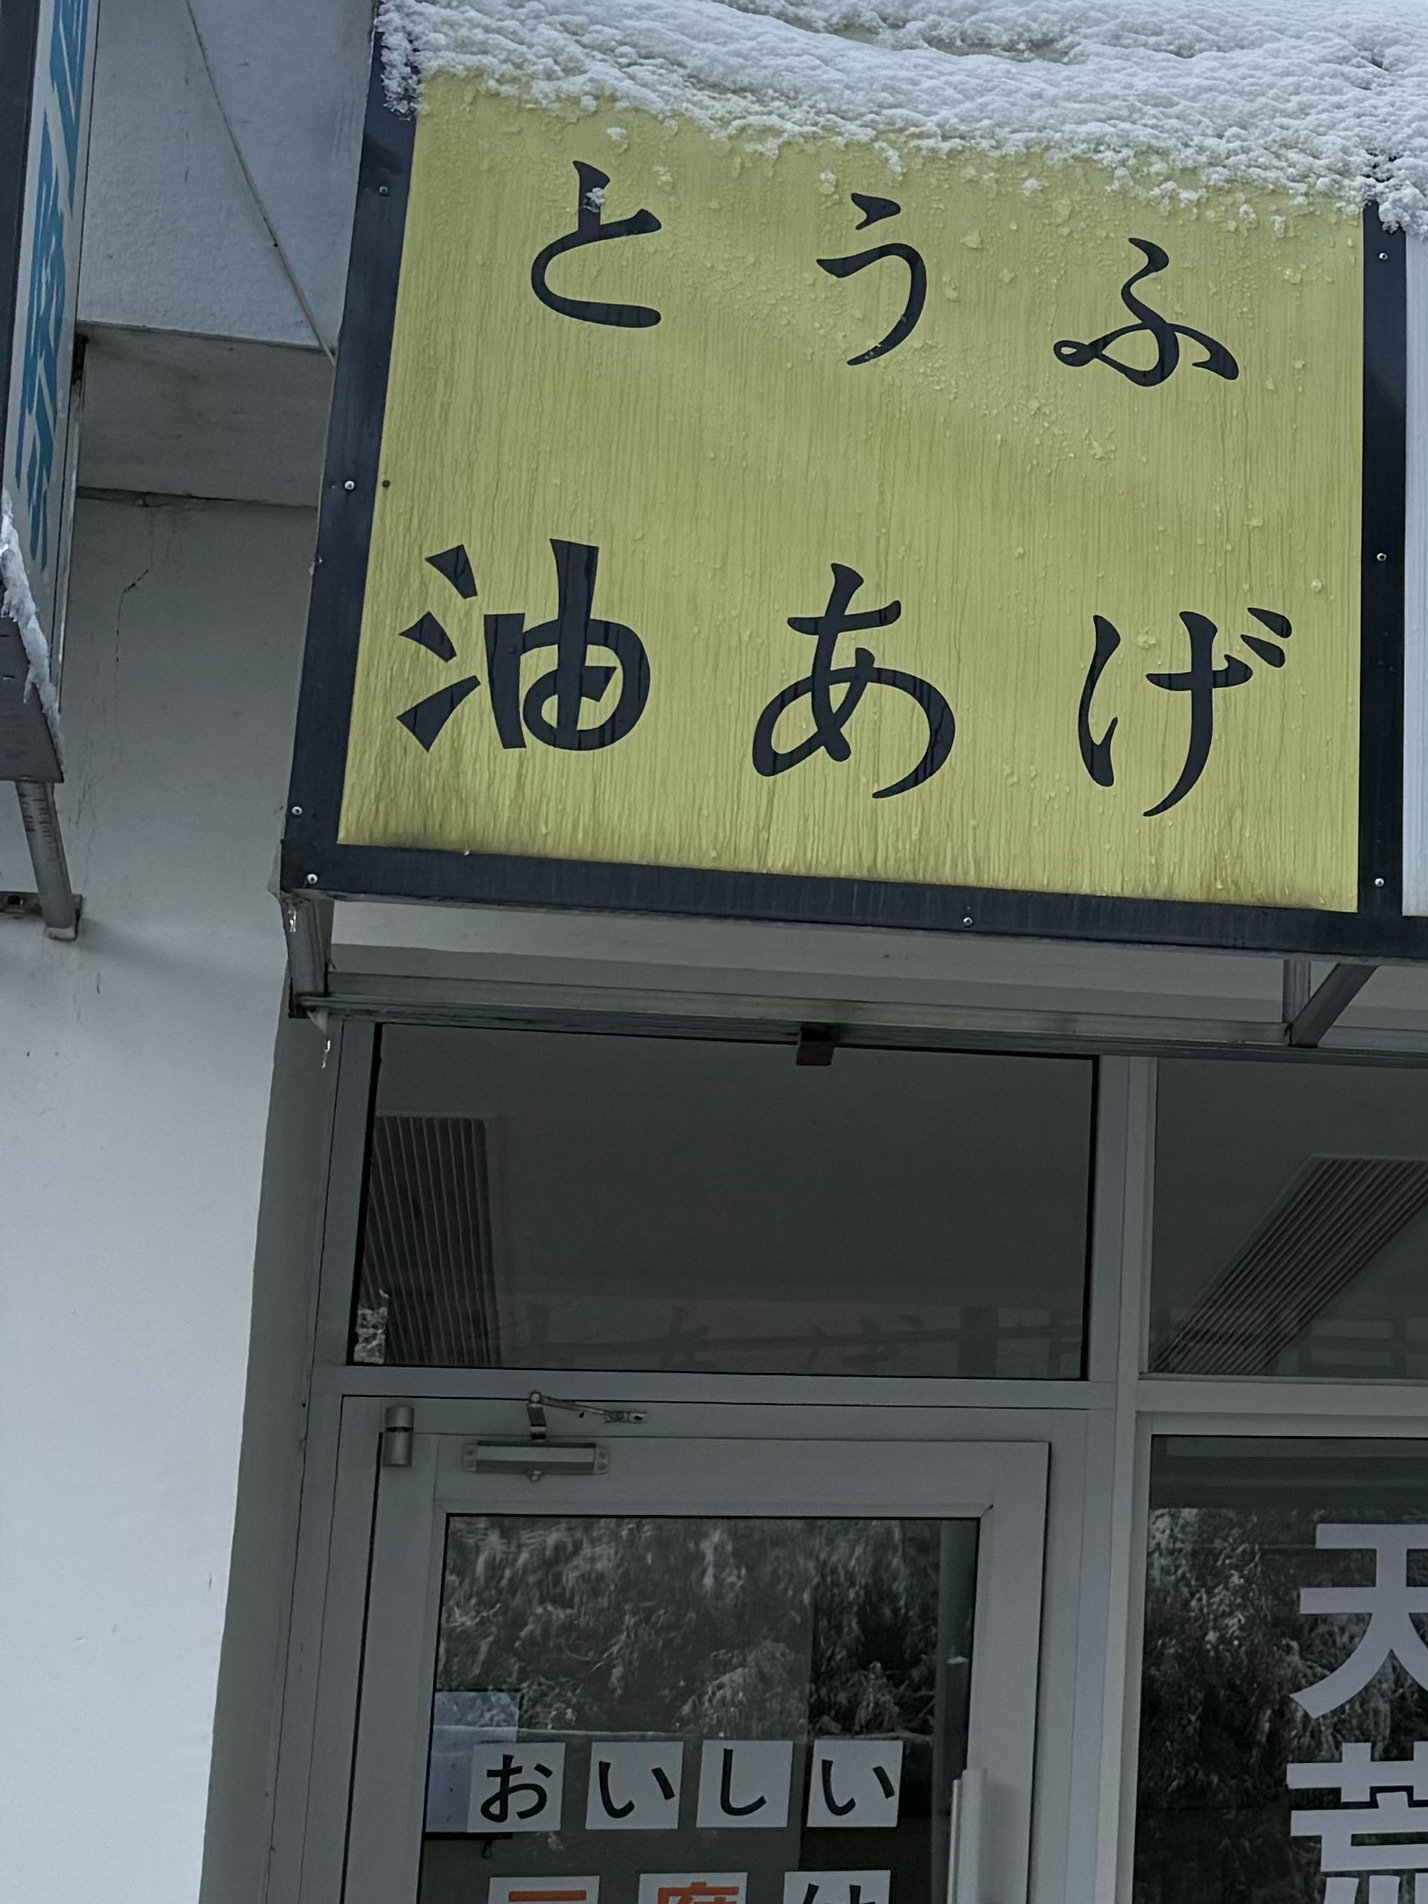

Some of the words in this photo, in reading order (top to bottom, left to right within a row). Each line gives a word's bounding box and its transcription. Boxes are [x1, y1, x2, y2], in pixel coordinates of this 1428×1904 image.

[531, 159, 1239, 387] とうふ
[397, 538, 1293, 818] 油あげ
[479, 1747, 897, 1824] おいしい
